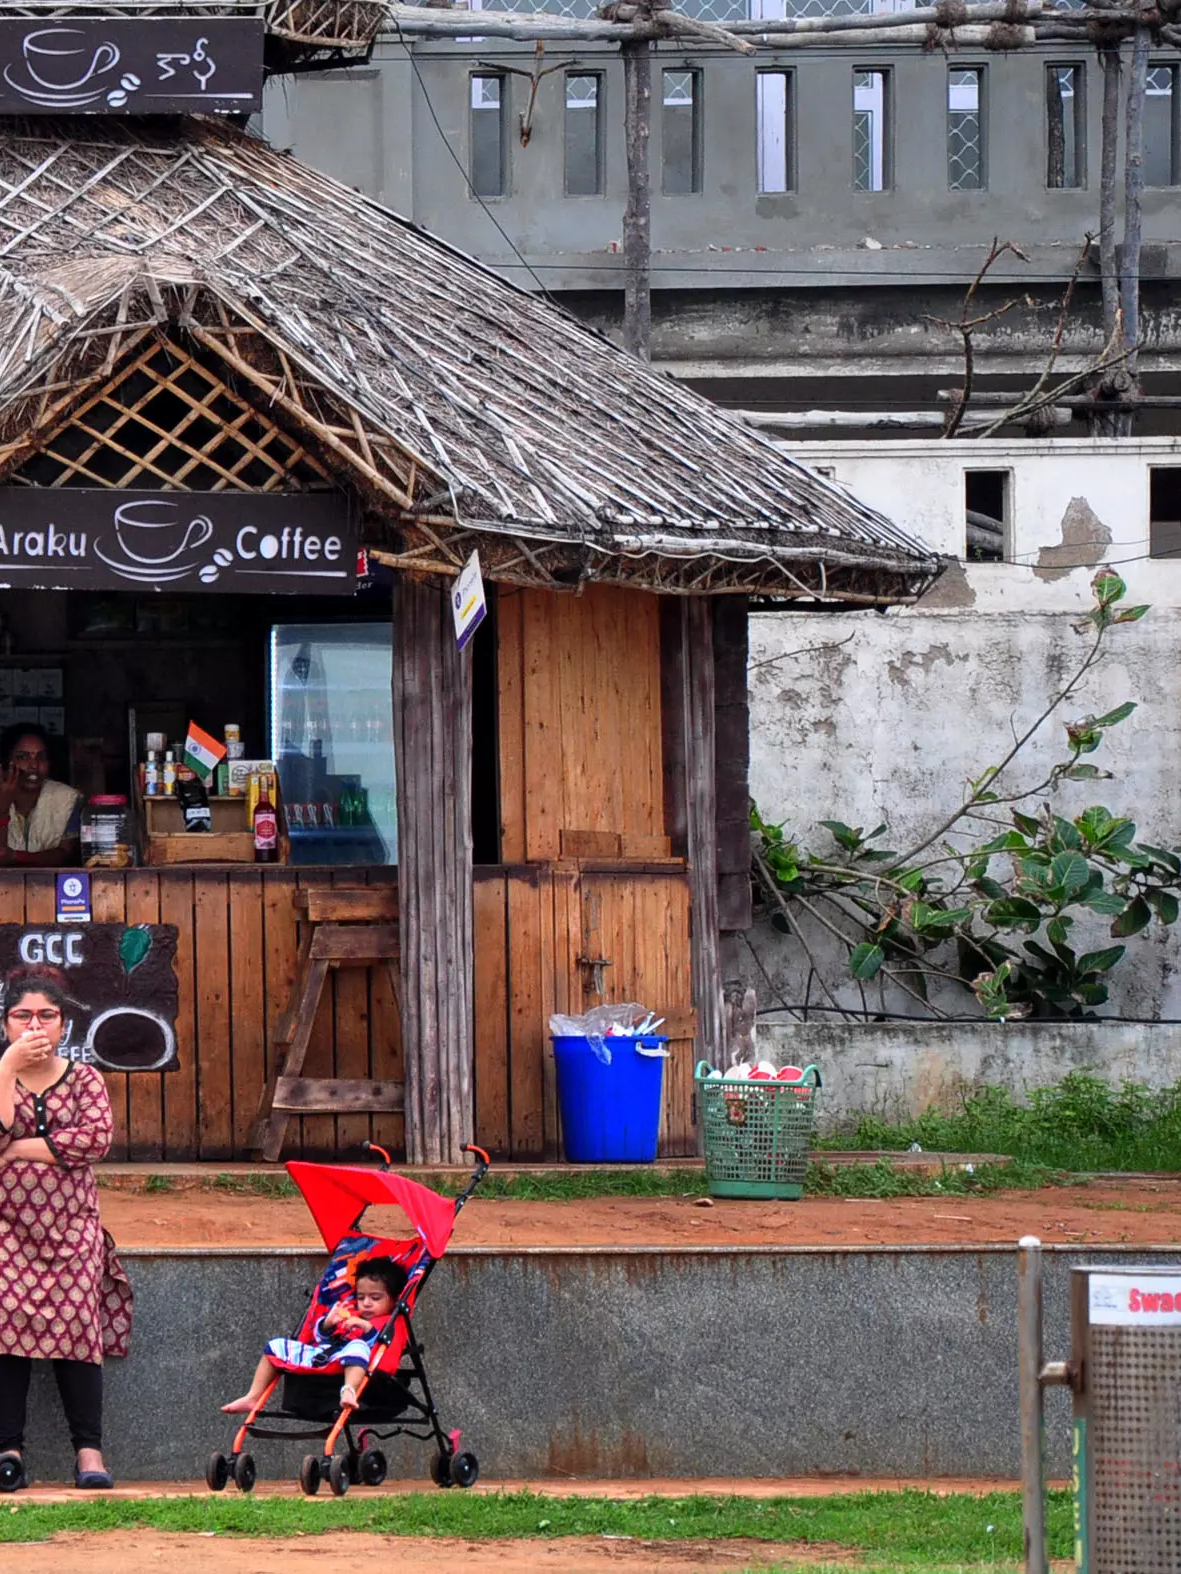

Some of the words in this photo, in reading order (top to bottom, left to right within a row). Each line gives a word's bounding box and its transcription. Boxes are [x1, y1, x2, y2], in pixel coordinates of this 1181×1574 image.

[156, 37, 216, 90] కాఫీ
[235, 524, 343, 561] Coffee
[20, 933, 83, 965] GCC
